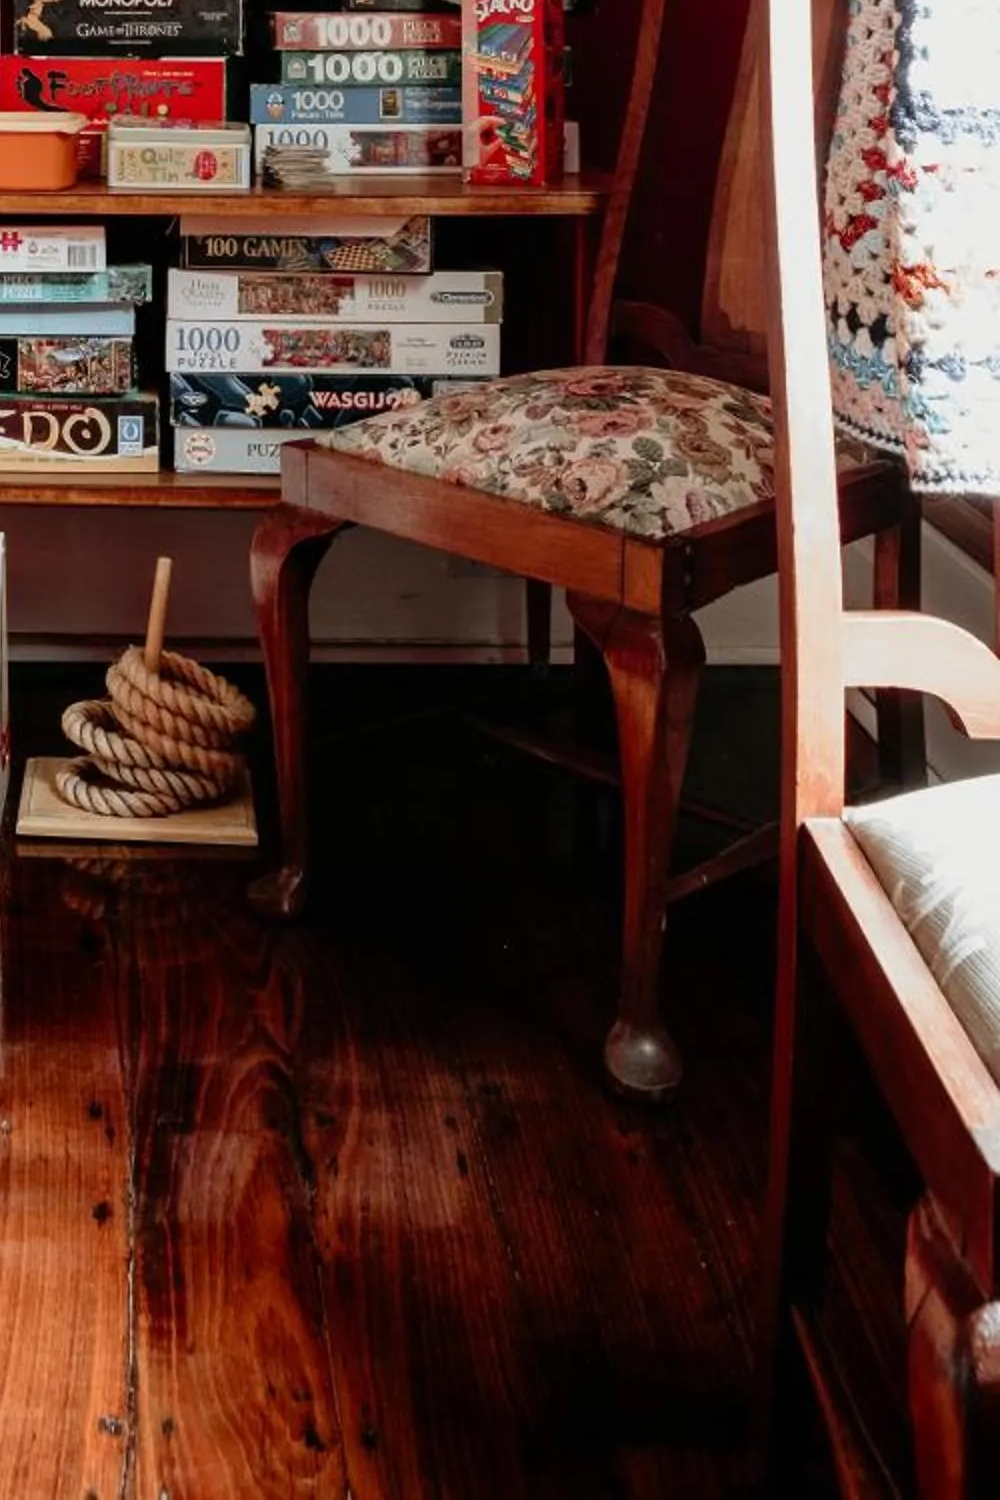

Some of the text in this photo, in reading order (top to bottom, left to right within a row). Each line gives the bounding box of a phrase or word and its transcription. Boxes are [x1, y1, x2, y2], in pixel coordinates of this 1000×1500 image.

[75, 23, 115, 38] GAME
[124, 21, 184, 38] THRONES
[313, 16, 392, 47] 1000
[307, 53, 403, 83] 1000
[291, 90, 345, 111] 1000
[267, 129, 328, 148] 1000
[205, 237, 309, 259] 100 GAMES
[367, 280, 407, 298] 1000
[175, 327, 241, 352] 1000
[177, 358, 238, 369] PUZZLE
[247, 443, 281, 458] PUZ
